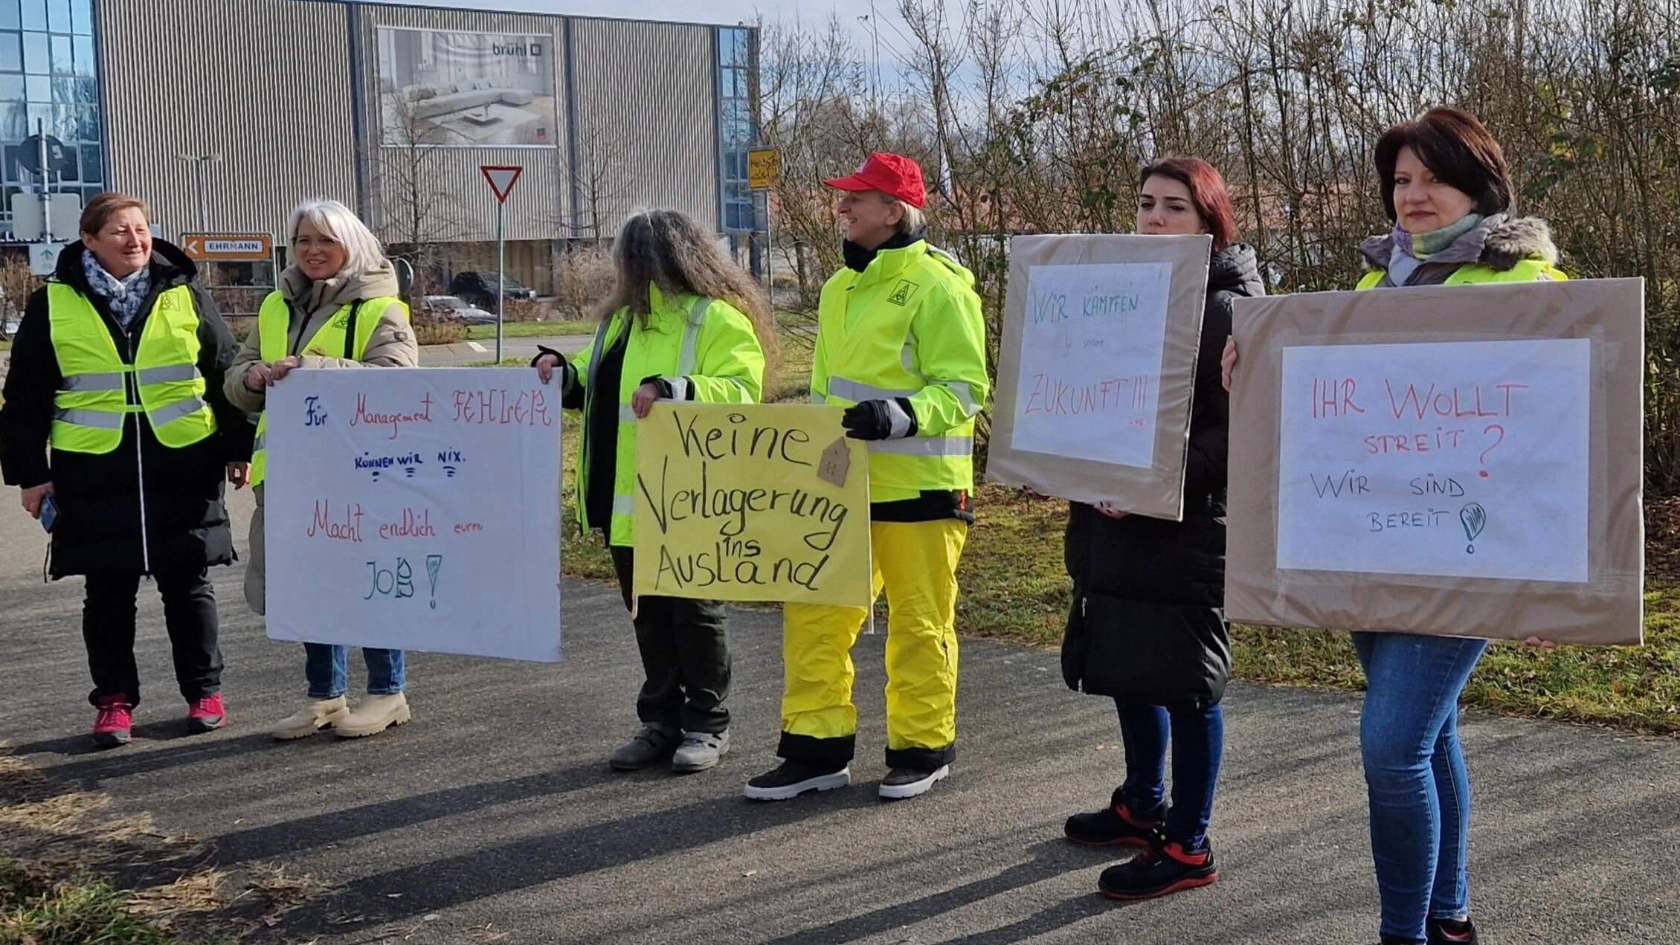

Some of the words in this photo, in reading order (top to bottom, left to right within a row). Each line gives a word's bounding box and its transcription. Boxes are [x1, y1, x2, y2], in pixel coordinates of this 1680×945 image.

[492, 41, 527, 56] brühl
[209, 242, 259, 250] EHRMANN
[349, 391, 435, 440] Management
[452, 388, 552, 427] FEHLER
[1312, 377, 1365, 419] IHR
[1384, 377, 1530, 420] WOLLT
[672, 410, 813, 467] Keine
[306, 498, 364, 542] Macht
[379, 507, 436, 539] endlich
[637, 454, 848, 552] Verlagerung
